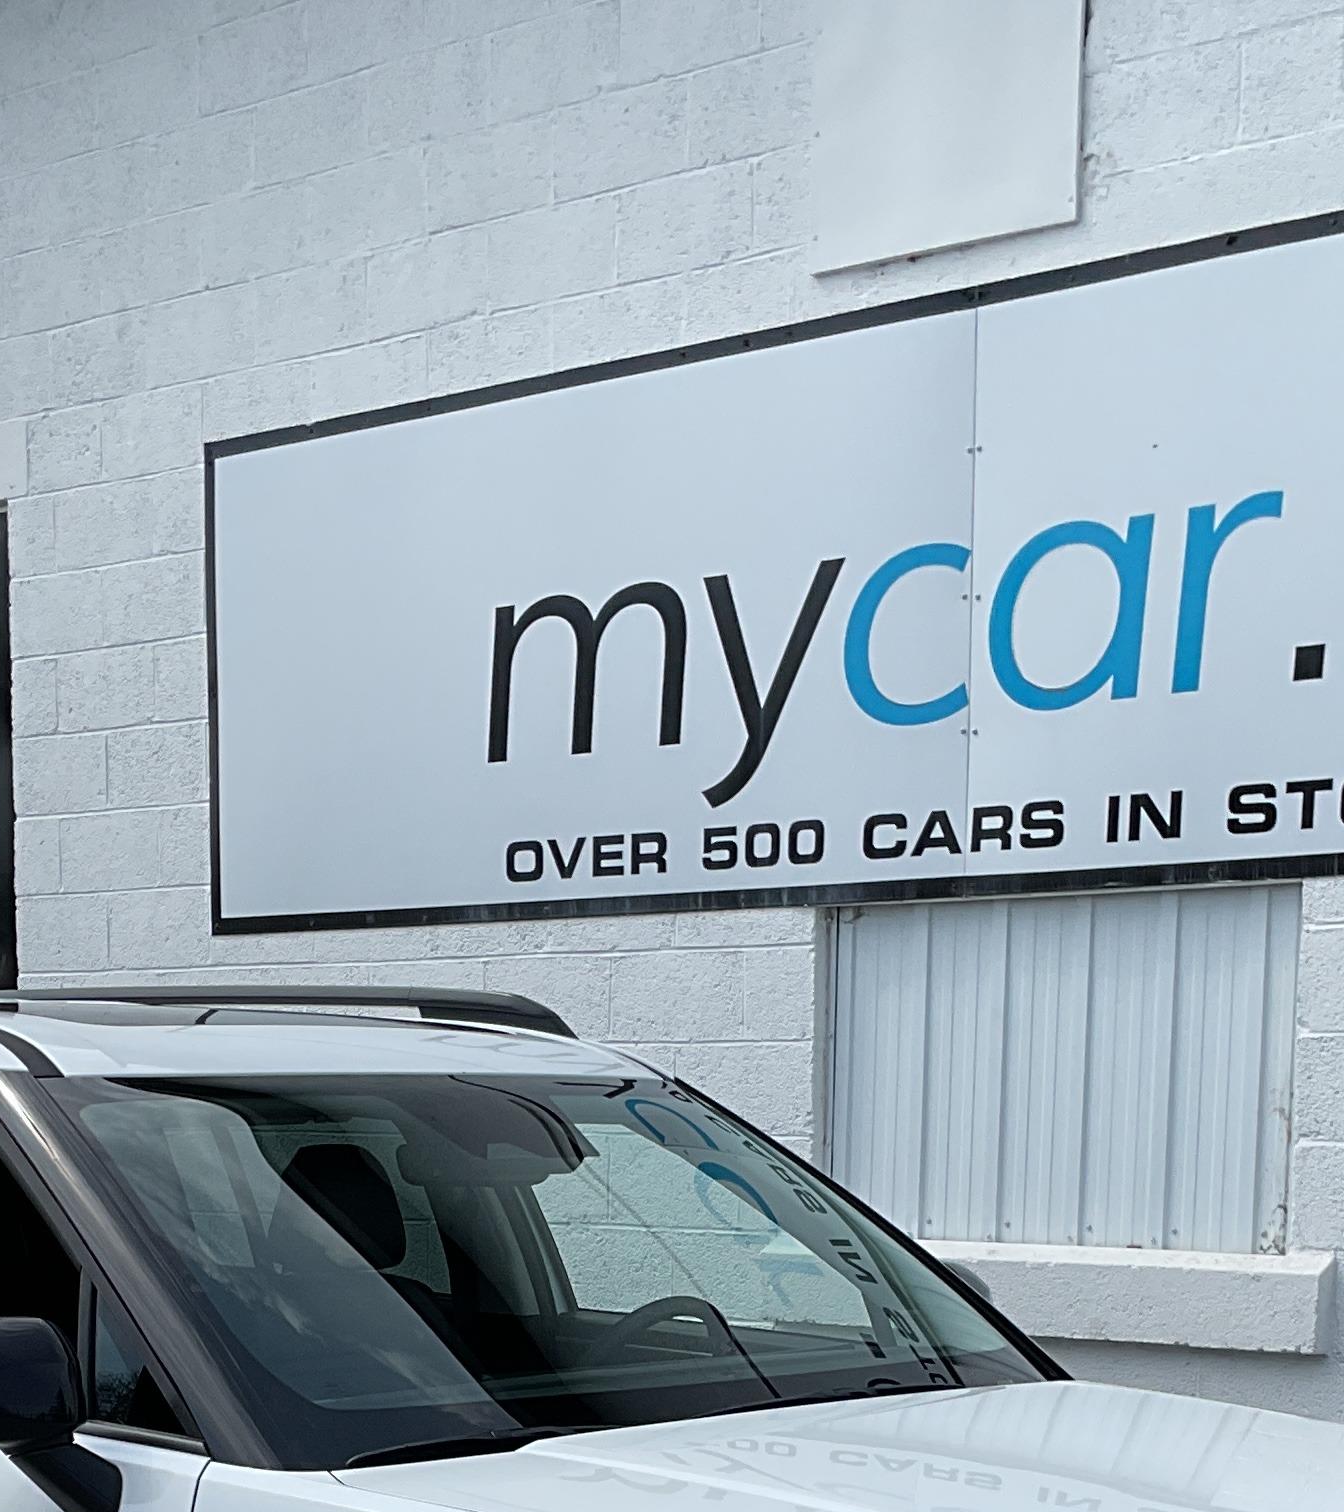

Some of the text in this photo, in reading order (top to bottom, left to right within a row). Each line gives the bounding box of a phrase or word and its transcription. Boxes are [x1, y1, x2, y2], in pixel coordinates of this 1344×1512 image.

[506, 831, 668, 883] OVER
[700, 819, 825, 871] 500
[862, 800, 1066, 860] CARS
[1106, 790, 1184, 843] IN
